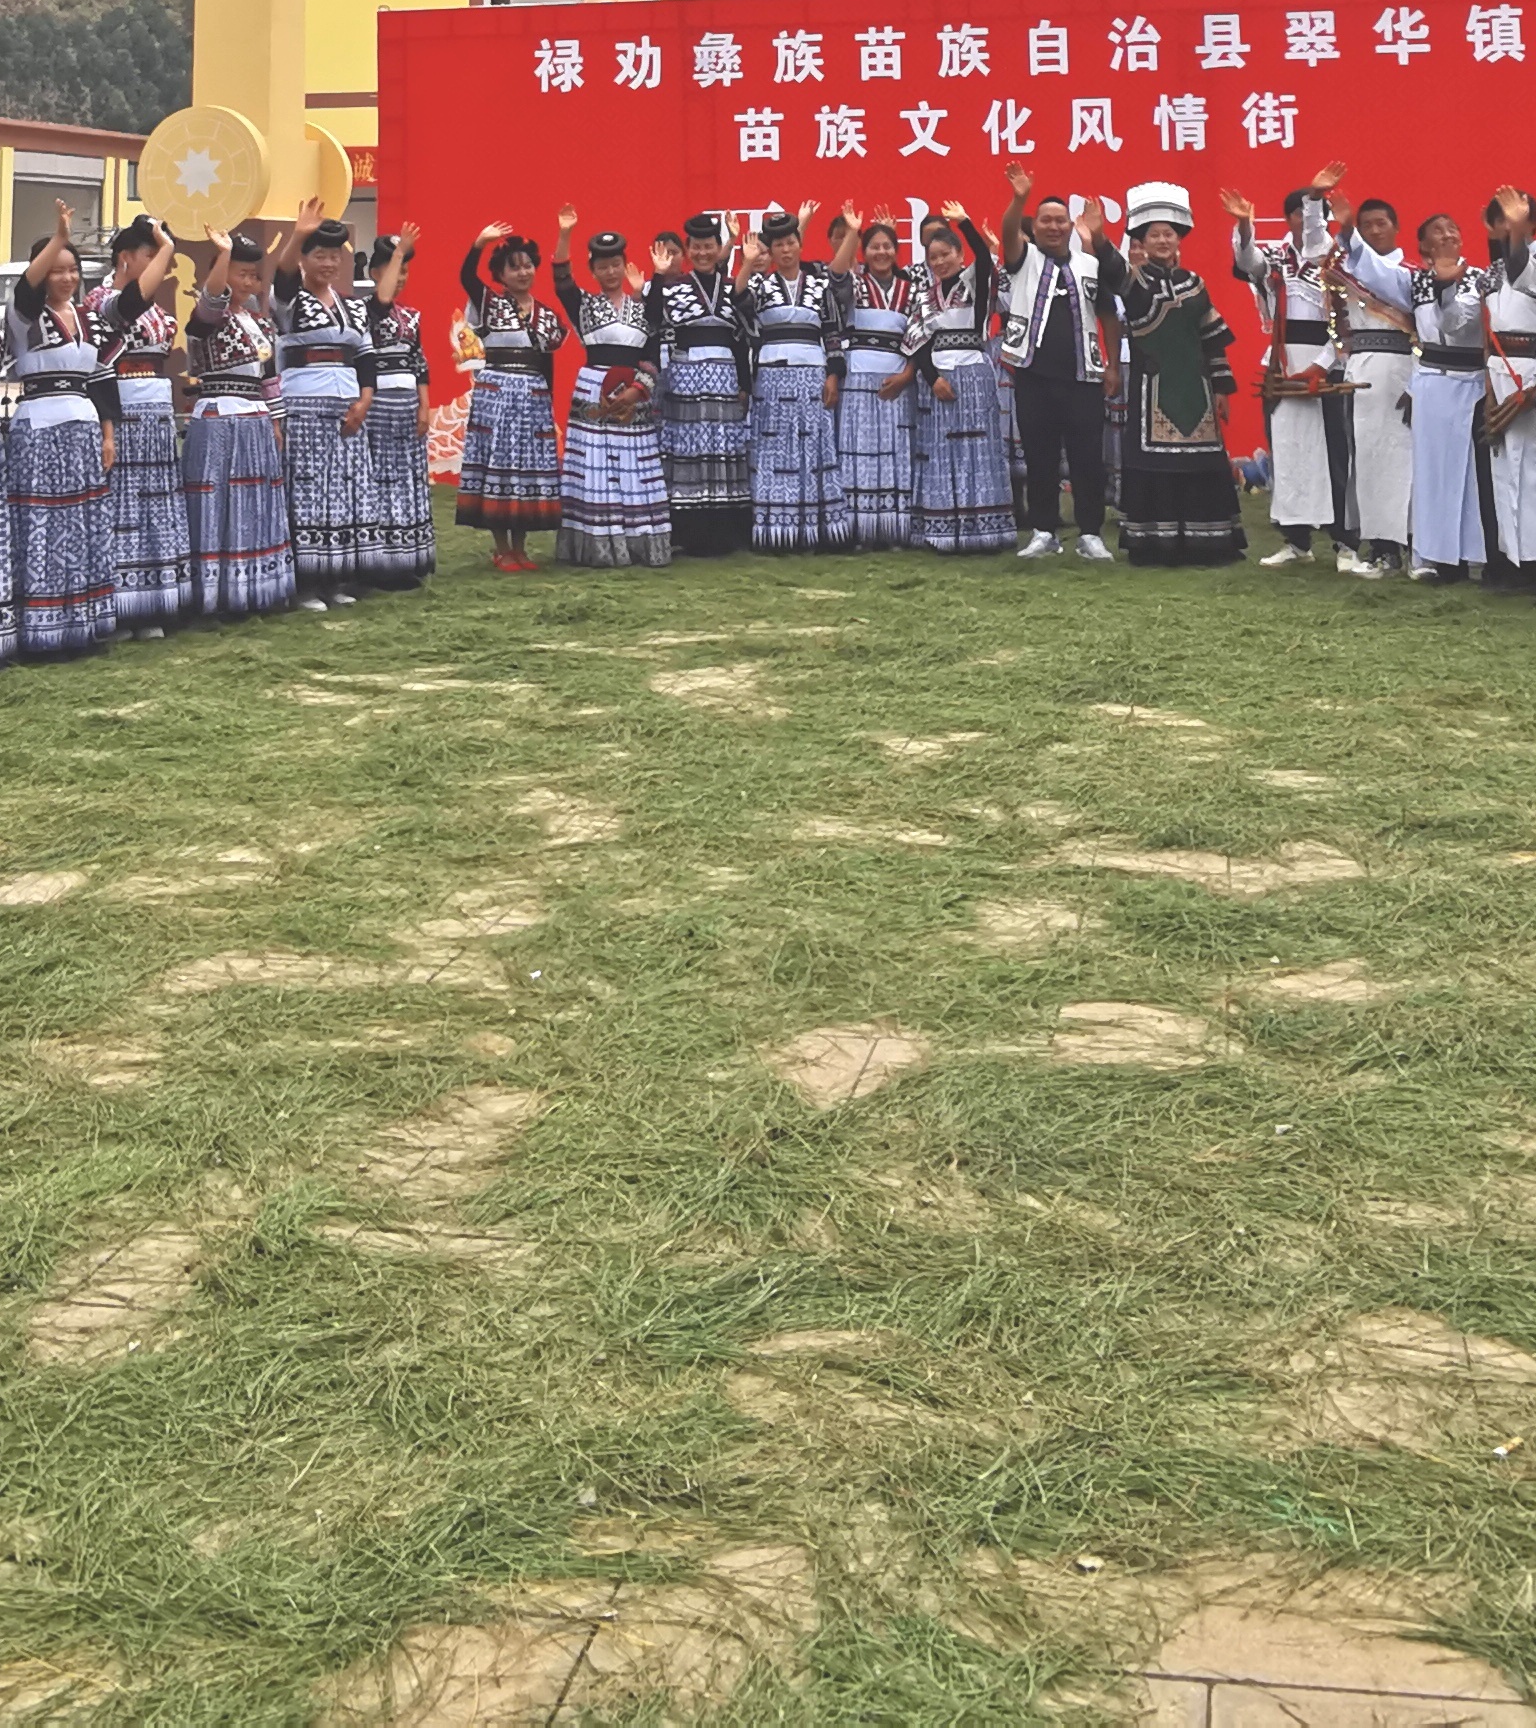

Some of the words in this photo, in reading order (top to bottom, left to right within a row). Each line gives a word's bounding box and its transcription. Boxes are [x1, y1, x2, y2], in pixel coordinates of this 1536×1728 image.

[535, 3, 1527, 94] 禄劝彝族苗族自治县翠华镇
[734, 91, 1298, 161] 苗族文化风情街
